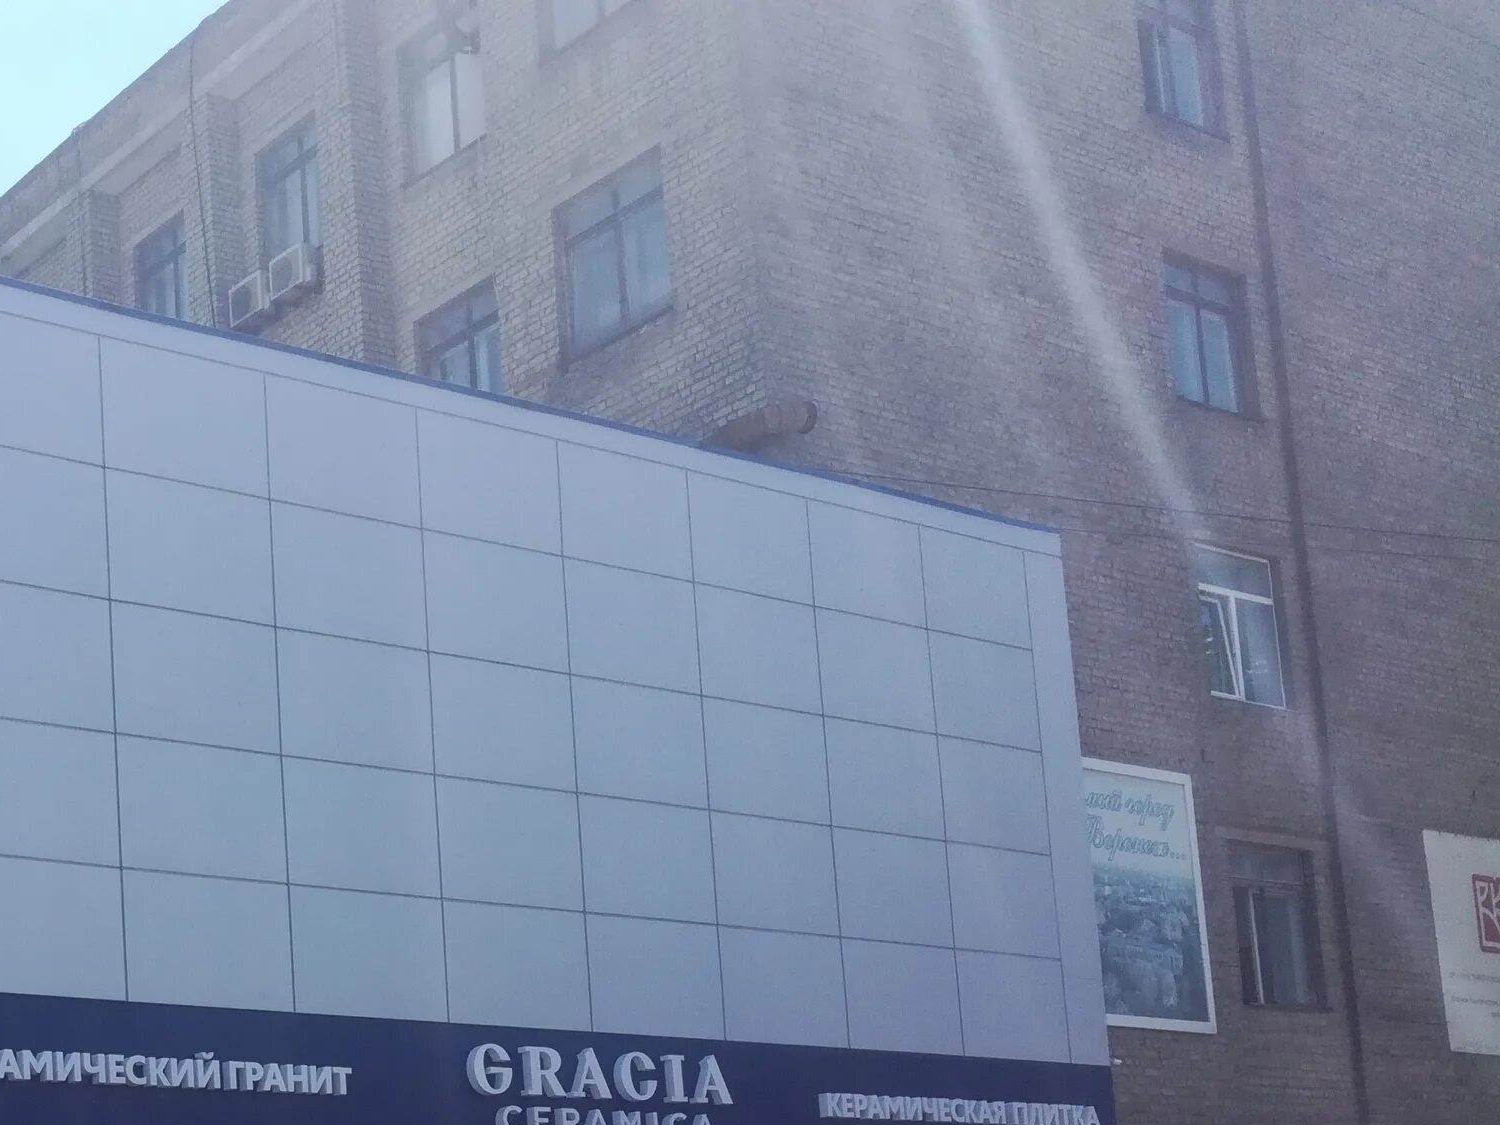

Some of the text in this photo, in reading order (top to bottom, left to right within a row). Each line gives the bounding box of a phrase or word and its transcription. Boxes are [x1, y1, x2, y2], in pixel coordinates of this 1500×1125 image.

[222, 1060, 352, 1095] ГРАНИТ
[466, 1043, 733, 1105] GRACIA
[818, 1092, 1006, 1125] КЕРАМИЧЕСКАЯ
